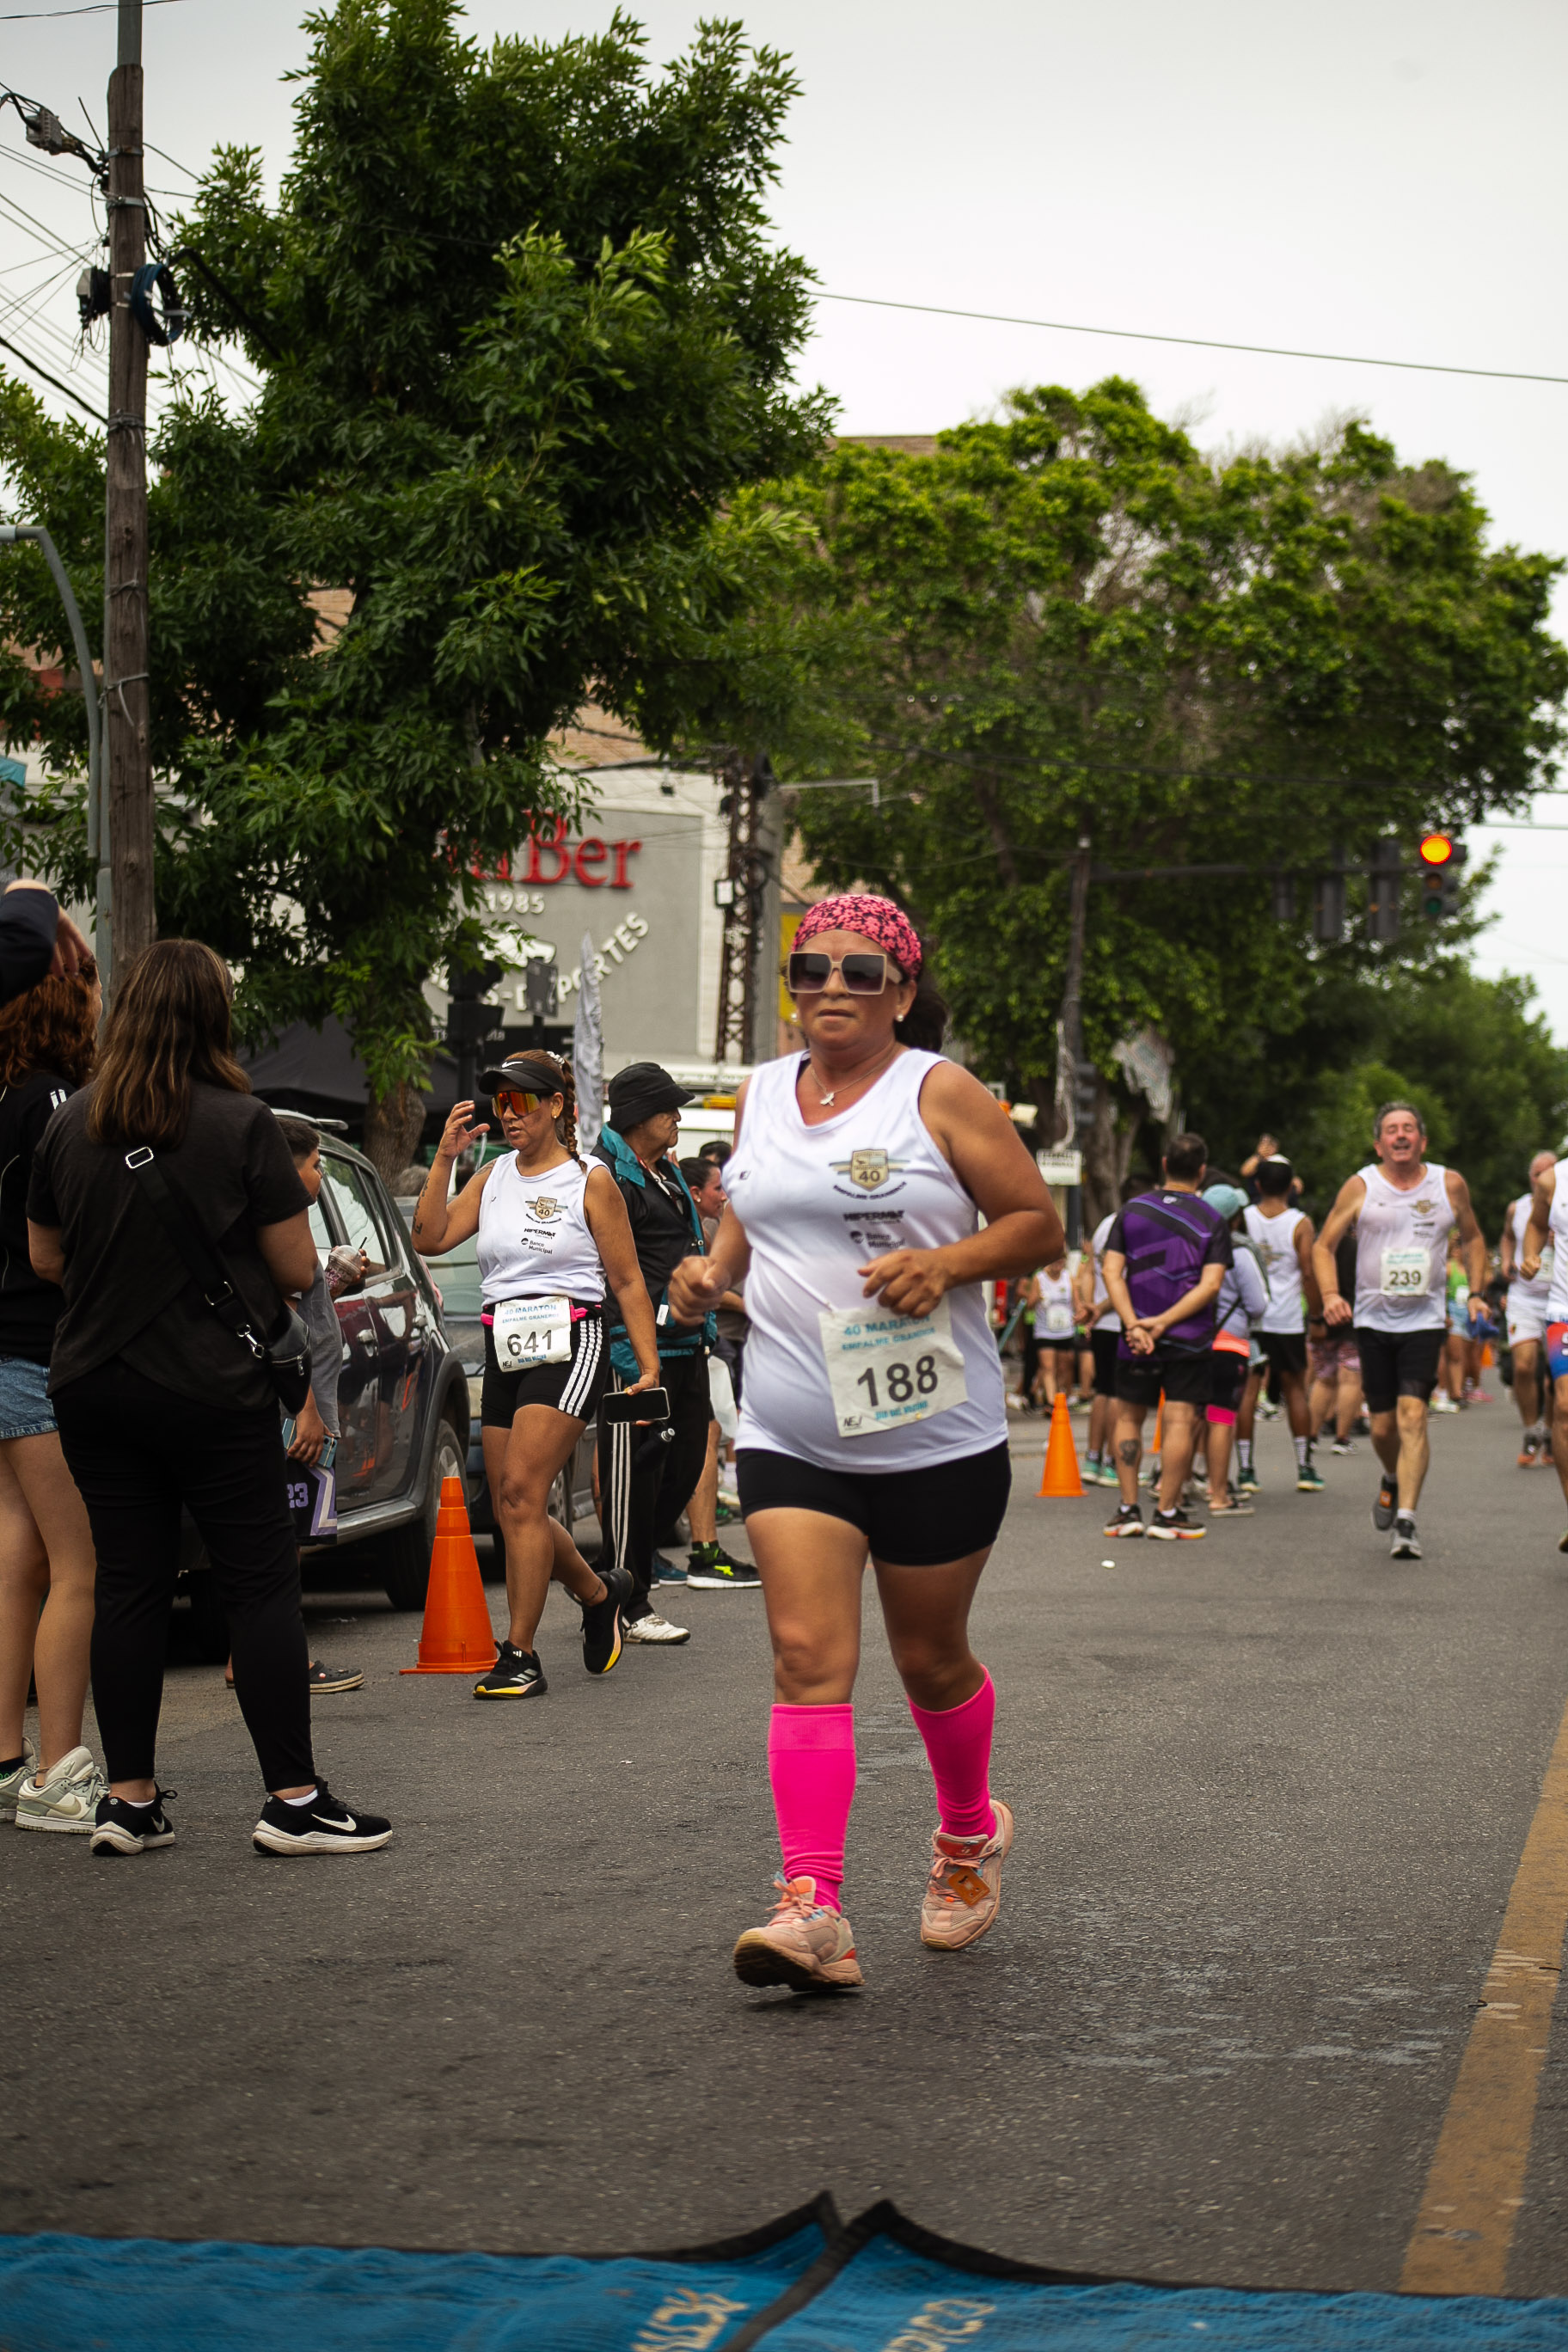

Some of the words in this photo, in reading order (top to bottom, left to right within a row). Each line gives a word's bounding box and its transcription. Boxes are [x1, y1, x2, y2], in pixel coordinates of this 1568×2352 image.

[484, 891, 546, 915] 1985
[859, 1170, 881, 1183] 40
[528, 1245, 554, 1255] Municipal
[1389, 1270, 1422, 1287] 239
[515, 1304, 557, 1314] MARATON
[502, 1315, 528, 1324] EMPALME
[843, 1324, 861, 1337] 40
[506, 1329, 553, 1357] 641
[857, 1355, 939, 1407] 188
